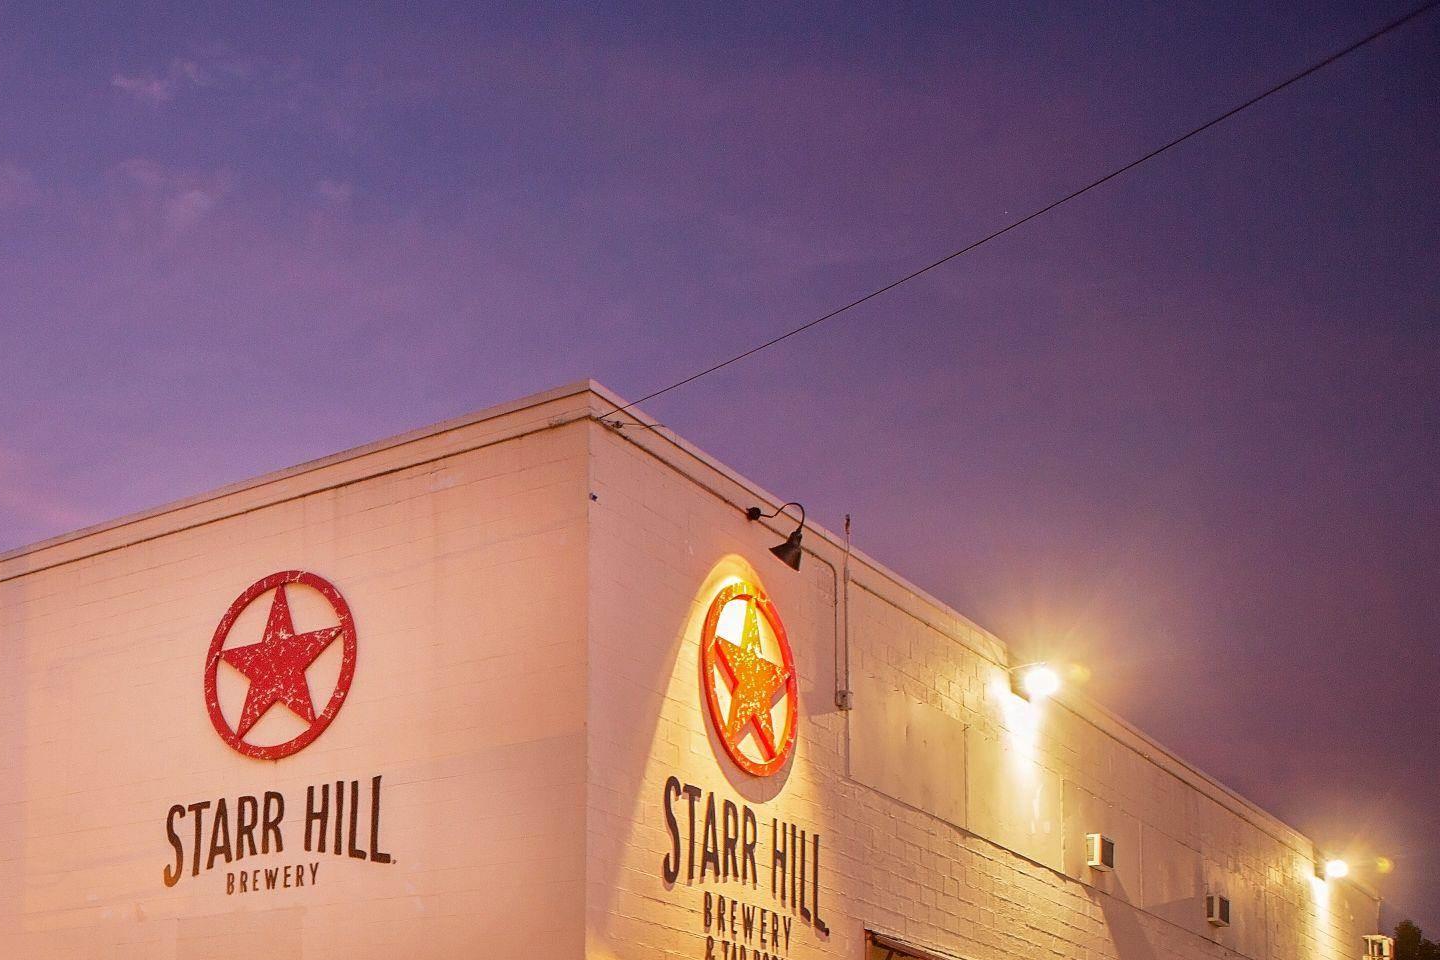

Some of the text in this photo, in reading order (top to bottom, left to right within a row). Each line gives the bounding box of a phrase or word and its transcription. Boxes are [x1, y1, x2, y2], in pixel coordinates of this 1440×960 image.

[163, 790, 285, 888] STARR
[663, 775, 758, 886] STARR
[226, 862, 320, 896] BREWERY
[703, 890, 792, 951] BREWERY
